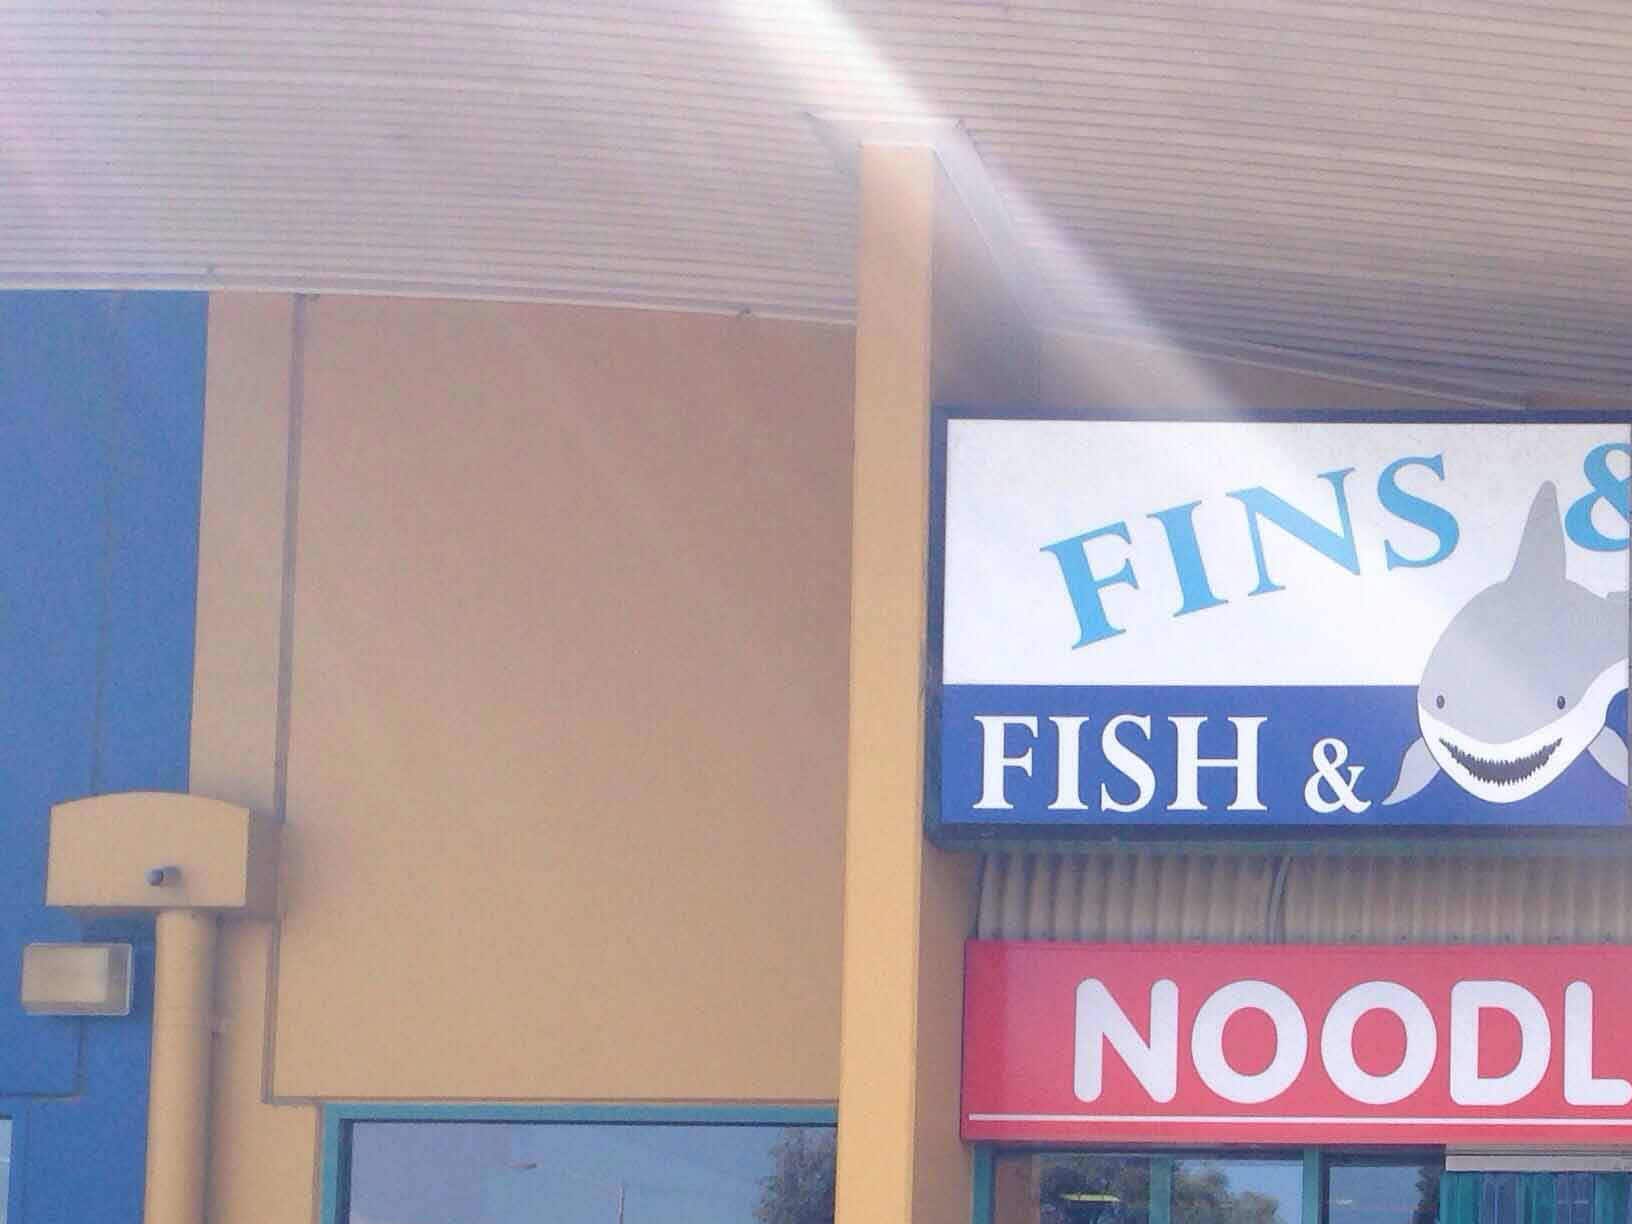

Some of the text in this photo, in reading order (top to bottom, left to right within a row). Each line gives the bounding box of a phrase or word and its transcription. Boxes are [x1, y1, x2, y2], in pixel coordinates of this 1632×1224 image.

[1040, 454, 1459, 650] FINS
[972, 714, 1268, 812] FISH
[1304, 737, 1371, 813] &
